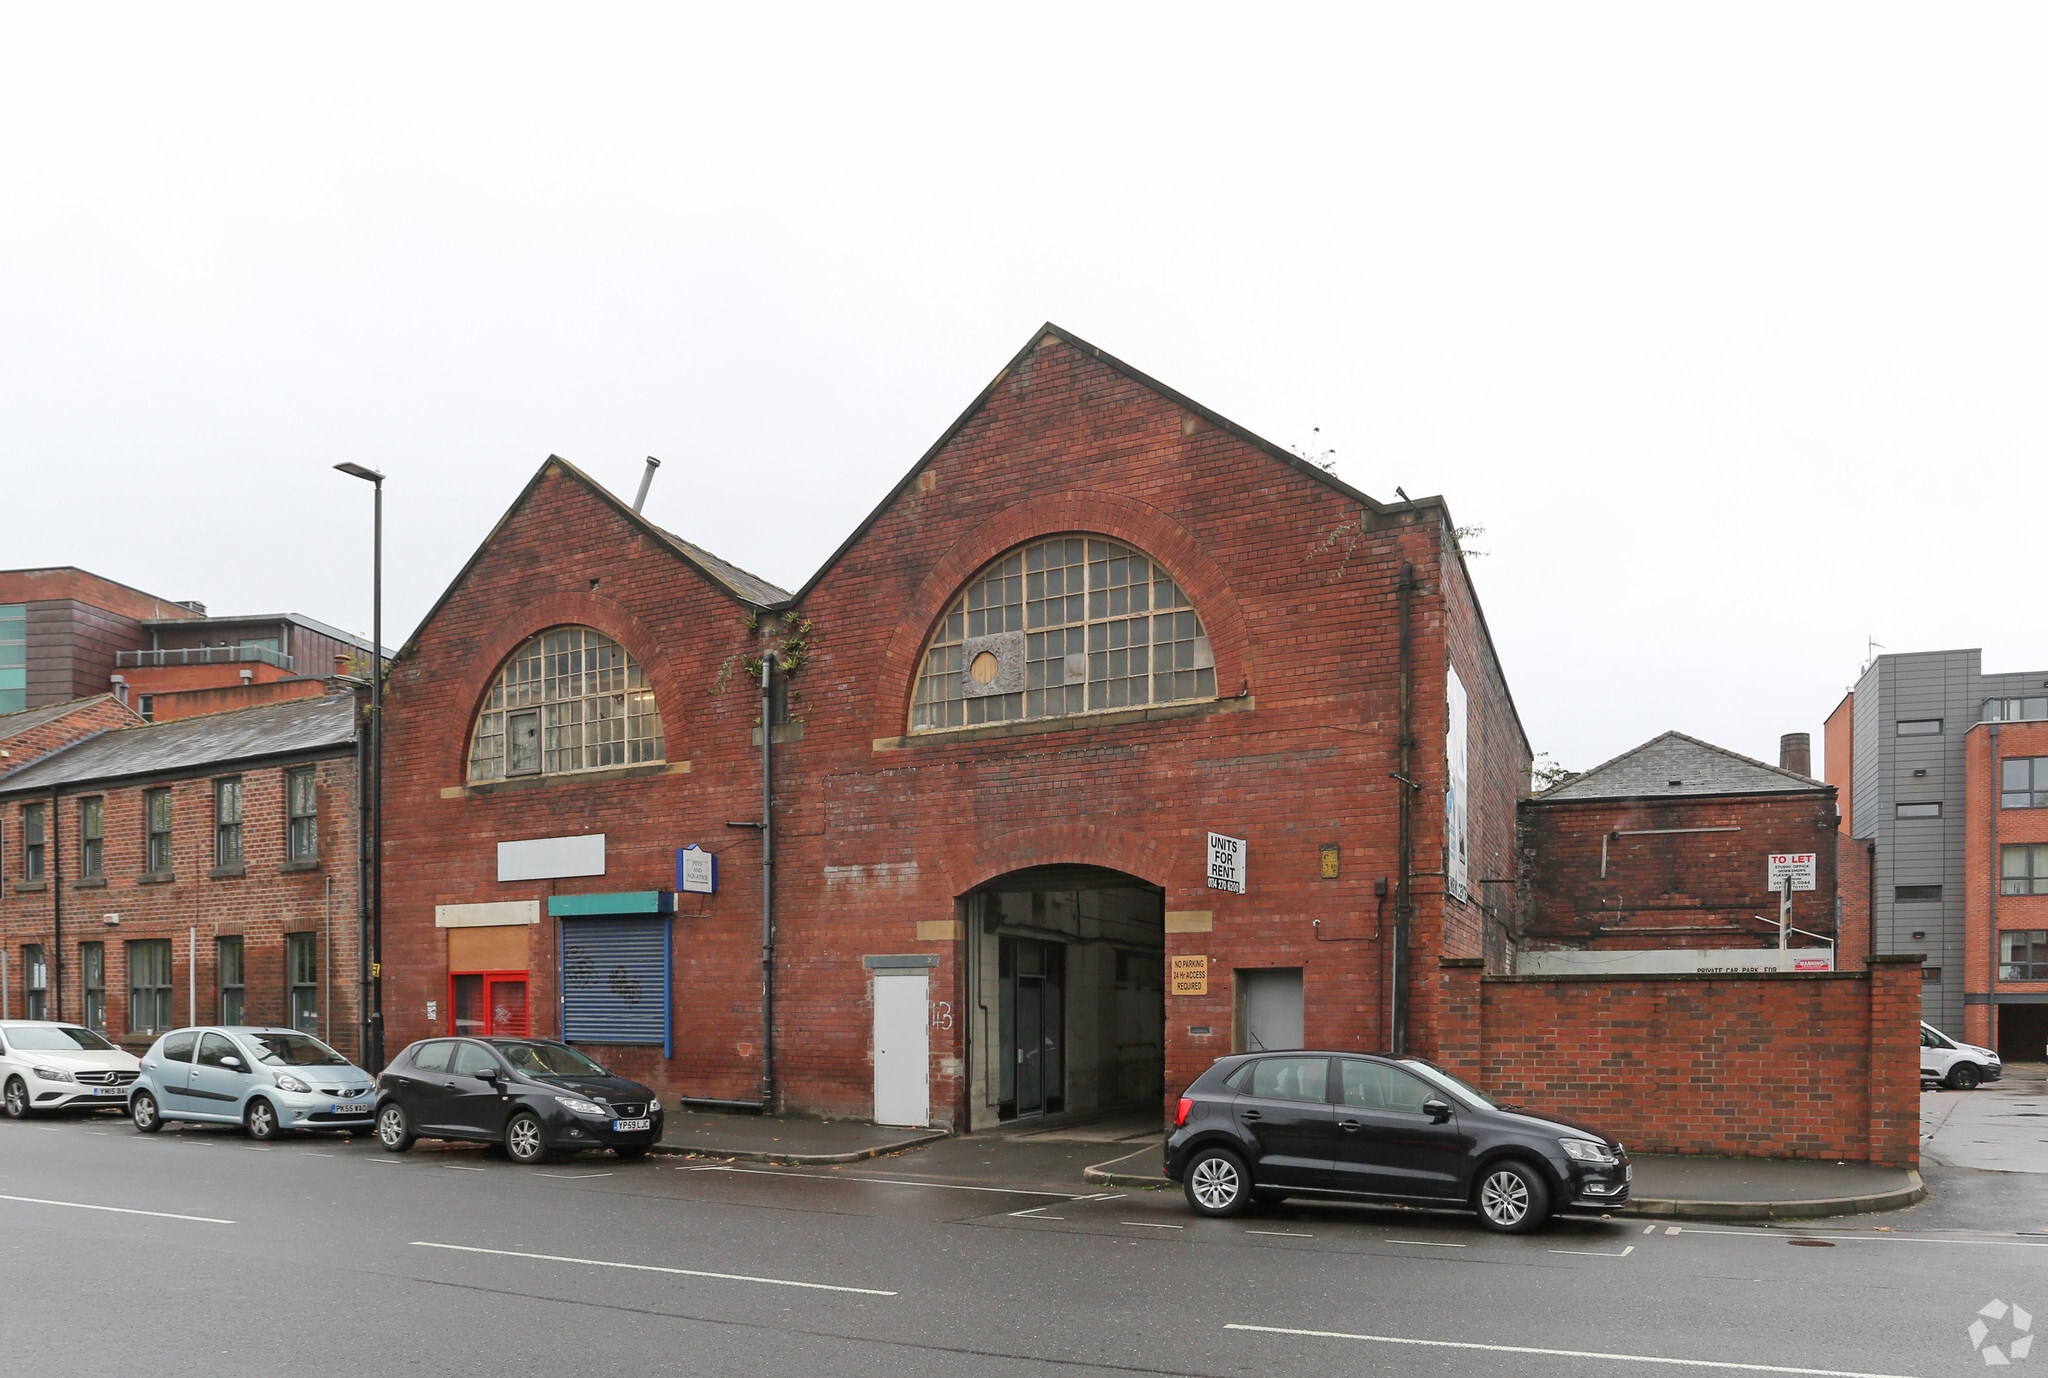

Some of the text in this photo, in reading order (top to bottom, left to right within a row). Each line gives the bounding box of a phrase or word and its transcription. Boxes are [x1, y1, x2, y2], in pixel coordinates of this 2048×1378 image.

[1211, 835, 1237, 853] UNITS
[1215, 850, 1233, 866] FOR
[1771, 855, 1812, 864] TO LET
[1212, 863, 1235, 879] RENT
[1174, 960, 1204, 968] NO PARKING
[1173, 971, 1179, 979] 24
[1186, 971, 1205, 979] ACCESS
[1177, 982, 1202, 990] REQUIRED
[618, 1120, 636, 1129] YP59
